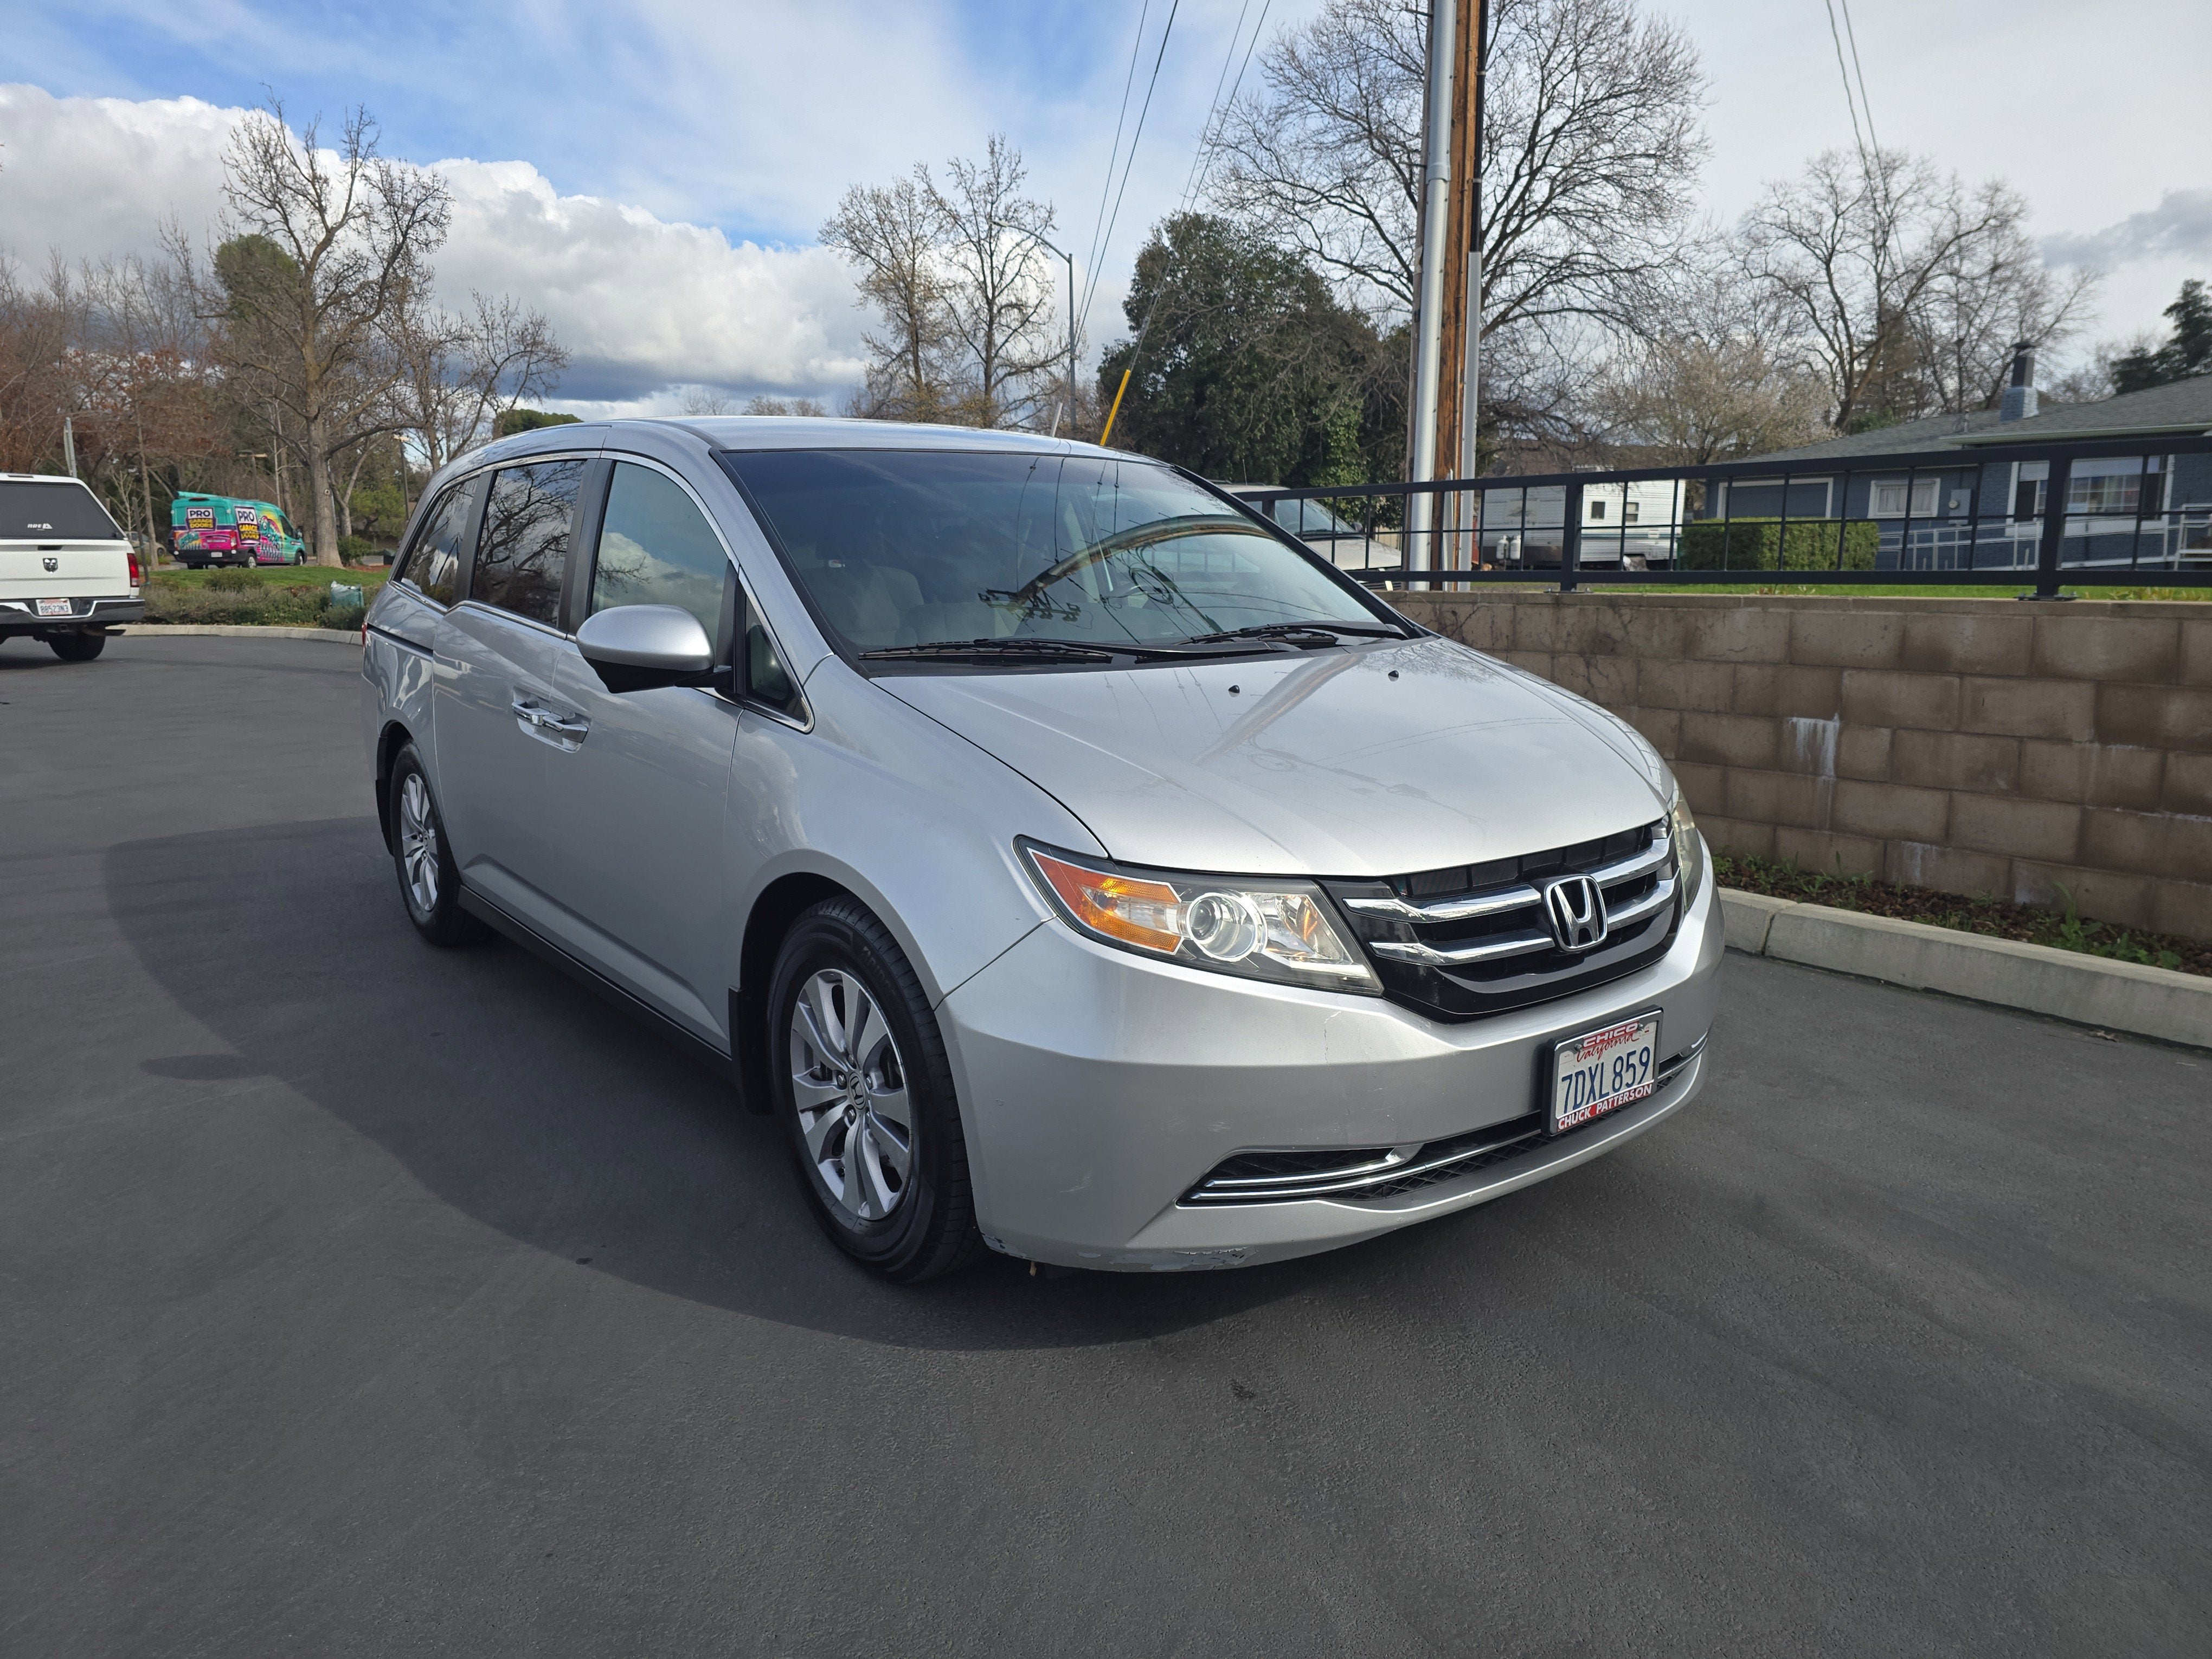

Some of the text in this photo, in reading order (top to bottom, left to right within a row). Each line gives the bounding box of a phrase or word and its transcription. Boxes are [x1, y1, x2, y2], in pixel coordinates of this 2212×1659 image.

[237, 511, 254, 522] PRO
[1577, 1033, 1639, 1063] California
[1583, 1023, 1638, 1047] CHICO
[1558, 1084, 1652, 1130] CHUCK PATTERSON
